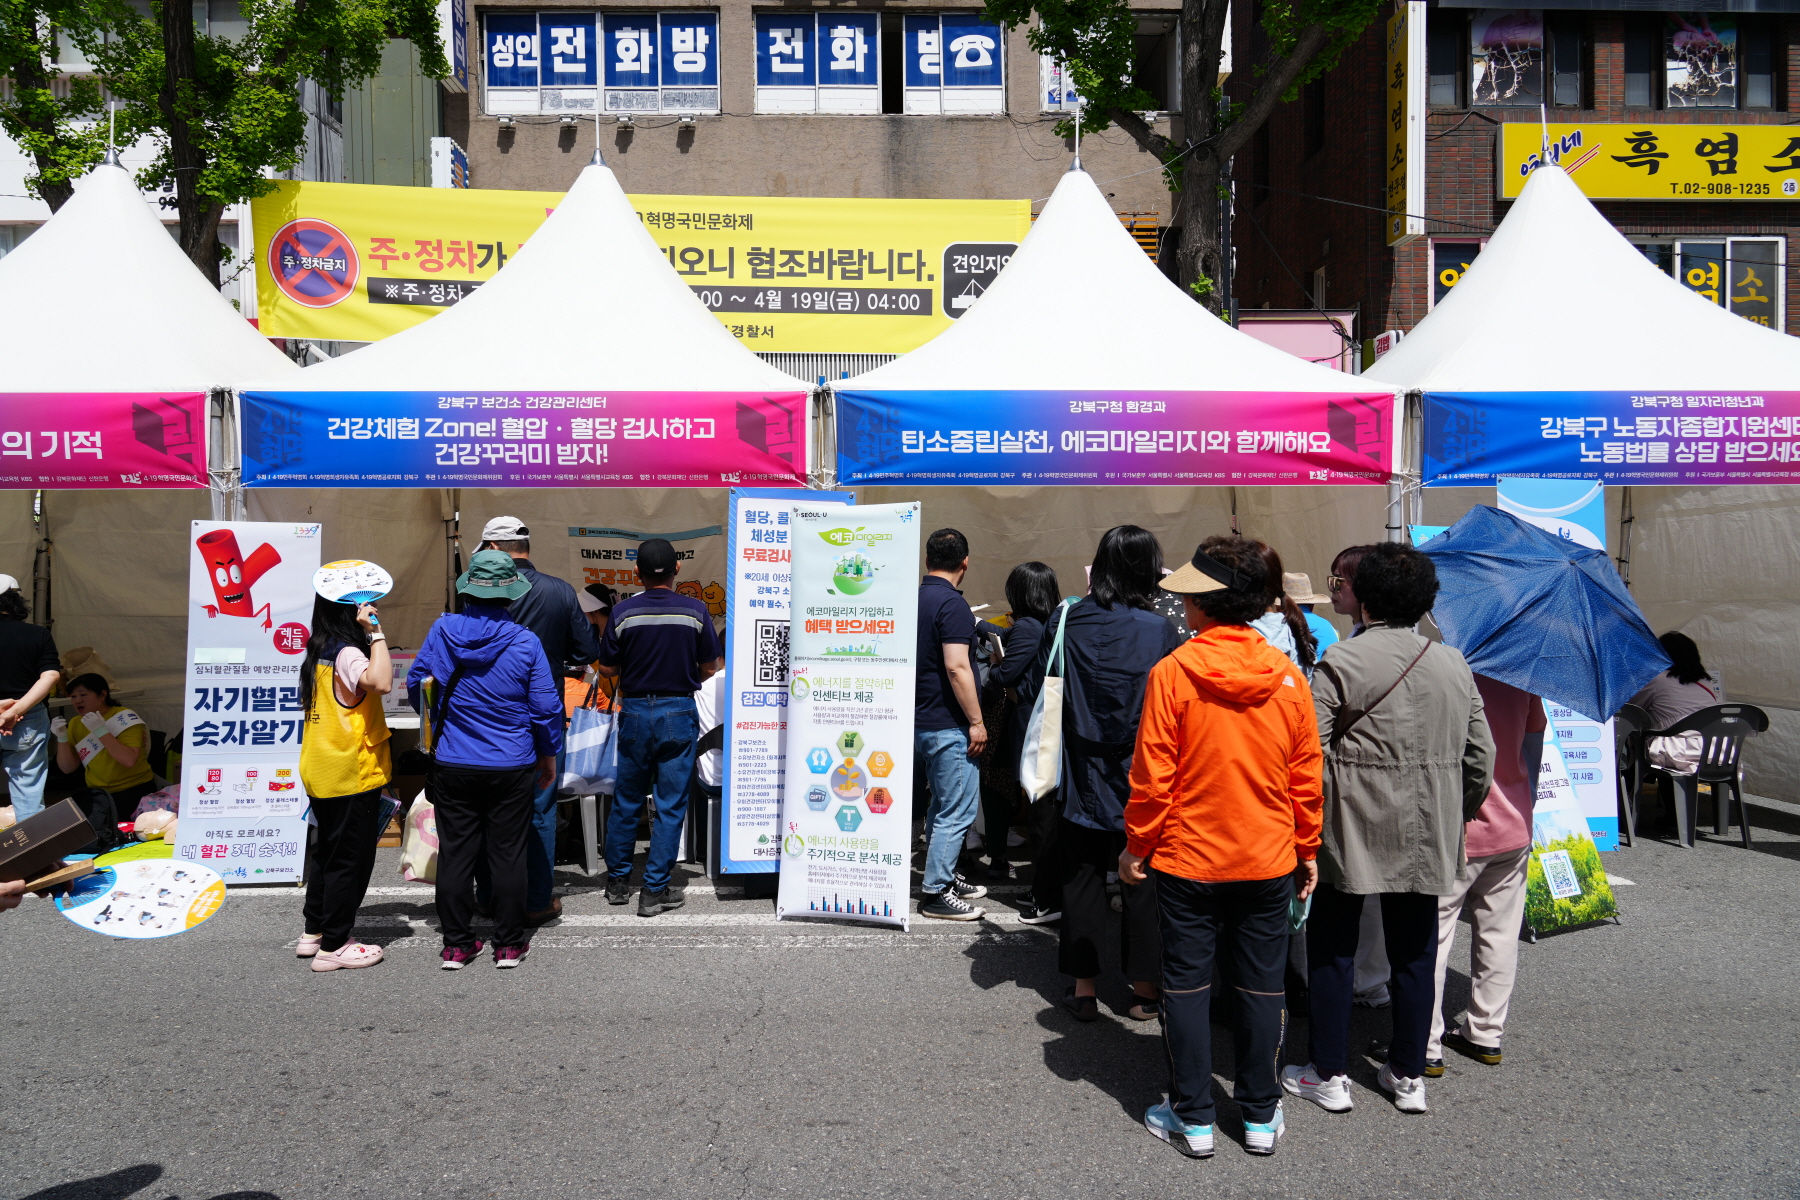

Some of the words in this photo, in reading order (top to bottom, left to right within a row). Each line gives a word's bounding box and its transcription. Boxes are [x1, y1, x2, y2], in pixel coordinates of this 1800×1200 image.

[492, 34, 537, 67] 성인
[1391, 61, 1405, 170] 흑염소
[1670, 182, 1770, 195] T.02-908-1235
[1783, 182, 1796, 192] 2층
[635, 211, 753, 231] 혁명국민문화제
[368, 237, 507, 274] 주·정차가
[284, 255, 346, 272] 주·정차금지
[747, 247, 935, 282] 협조바랍니다.
[755, 291, 782, 310] 4월
[791, 292, 860, 312] 19일(금)
[867, 294, 920, 310] 04:00
[725, 325, 774, 339] 경찰서
[438, 397, 478, 409] 강북구
[482, 397, 521, 409] 보건소
[526, 397, 607, 409] 건강관리센터
[1069, 400, 1122, 413] 강북구청
[1126, 400, 1166, 413] 환경과
[1631, 396, 1682, 408] 강북구청
[1686, 396, 1764, 408] 일자리청년과
[328, 418, 419, 439] 건강체험
[424, 418, 496, 438] Zone!
[502, 418, 548, 439] 혈압
[571, 418, 617, 439] 혈당
[623, 418, 715, 439] 검사하고
[1540, 417, 1607, 439] 강북구
[40, 431, 103, 460] 기적
[902, 430, 1054, 453] 탄소중립실천,
[1061, 430, 1231, 453] 에코마일리지와
[1237, 430, 1331, 453] 함께해요
[436, 443, 549, 465] 건강꾸러미
[556, 443, 608, 465] 받자!
[1580, 442, 1670, 463] 노동법률
[1675, 442, 1719, 463] 상담
[745, 510, 773, 525] 혈당,
[777, 511, 791, 525] 콜
[293, 526, 318, 535] 1339
[751, 529, 788, 543] 체성분
[581, 548, 622, 560] 대사검진
[743, 548, 791, 563] 무료검사
[757, 586, 780, 595] 강북구
[749, 599, 765, 608] 예약
[767, 599, 784, 609] 필수,
[806, 606, 857, 617] 에코마일리지
[860, 606, 894, 617] 가입하고
[279, 628, 303, 637] 레드
[805, 619, 832, 634] 혜택
[836, 619, 895, 634] 받으세요!
[280, 638, 306, 649] 서클
[195, 665, 250, 674] 심뇌혈관질환
[253, 665, 302, 674] 예방관리주
[813, 677, 852, 689] 에너지를
[854, 678, 895, 690] 절약하면
[193, 686, 304, 712] 자기혈관
[742, 692, 764, 706] 검진
[766, 692, 788, 707] 예약
[813, 690, 852, 702] 인센티브
[854, 690, 874, 703] 제공
[1550, 709, 1572, 717] 동상담
[192, 719, 303, 746] 숫자알기
[736, 721, 779, 730] #검진가능한
[1580, 772, 1593, 780] 사업
[205, 830, 234, 839] 아직도
[236, 829, 281, 838] 모르세요?
[182, 844, 197, 859] 내
[200, 844, 229, 858] 혈관
[231, 843, 256, 857] 3대
[259, 841, 297, 857] 숫자!!
[808, 835, 837, 848] 에너지
[839, 837, 879, 850] 사용량을
[807, 849, 856, 862] 주기적으로
[859, 852, 879, 865] 분석
[882, 853, 902, 866] 제공
